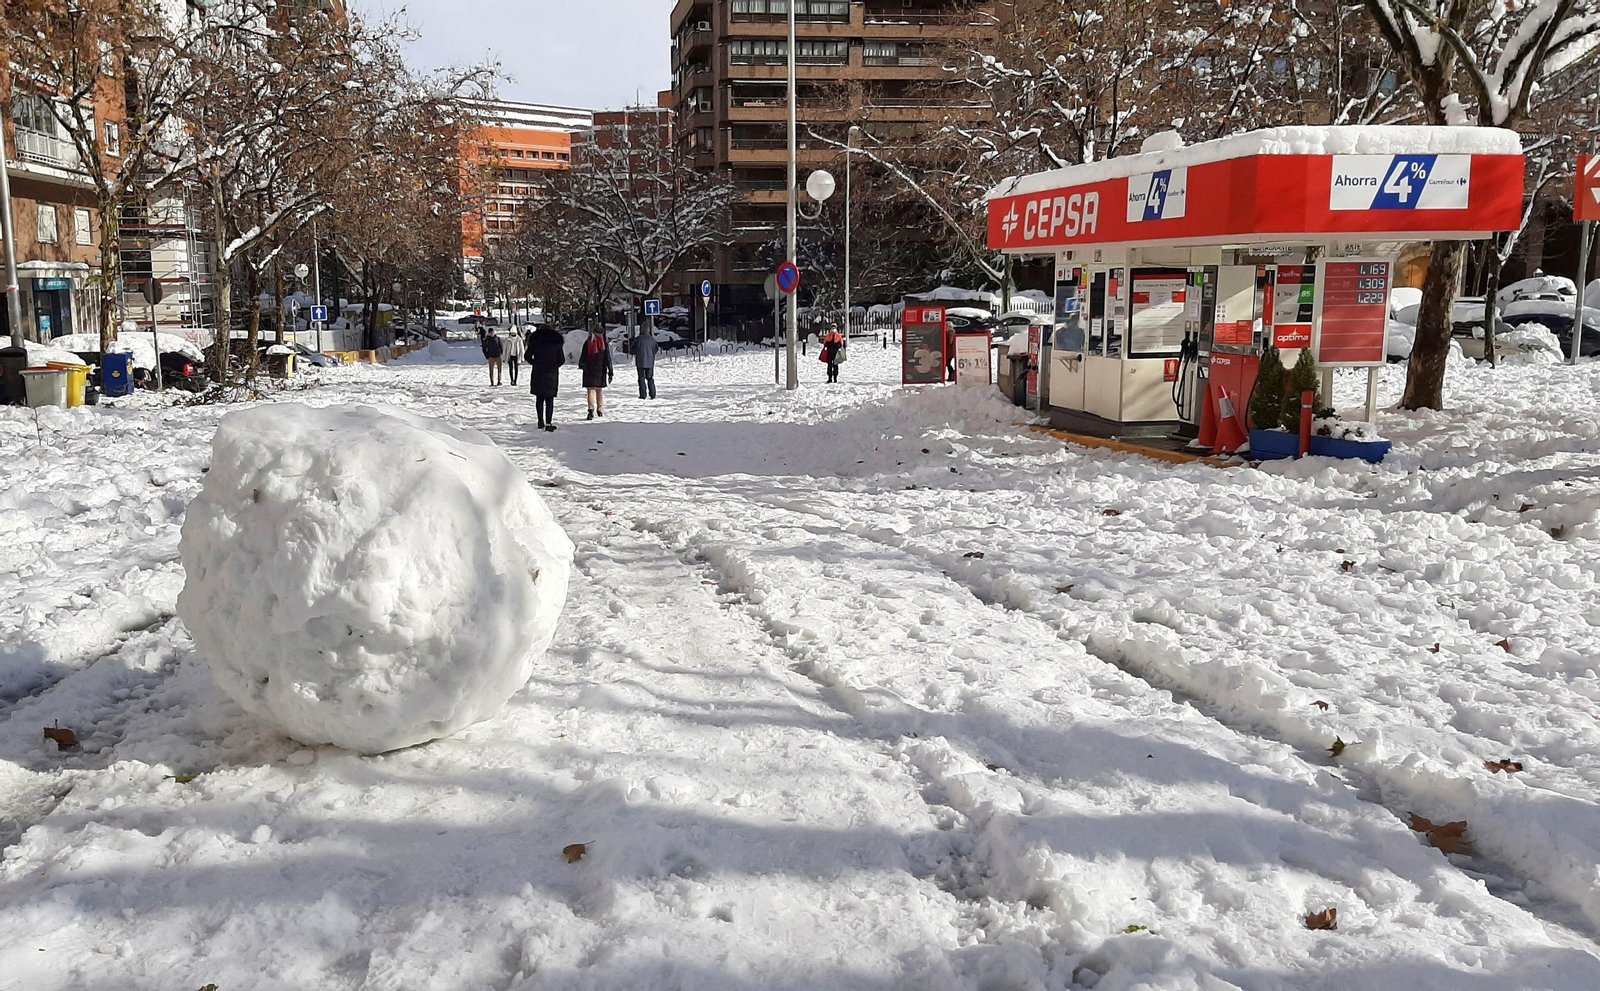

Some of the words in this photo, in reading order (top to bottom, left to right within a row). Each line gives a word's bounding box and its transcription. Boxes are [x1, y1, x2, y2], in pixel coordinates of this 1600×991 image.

[1334, 174, 1377, 187] Ahorra
[1383, 161, 1427, 203] 4%
[1129, 191, 1146, 202] Ahorra
[1147, 177, 1167, 214] 4%
[1023, 191, 1099, 241] CEPSA
[1360, 264, 1386, 275] 1.169
[1359, 278, 1385, 289] 1.309
[1357, 292, 1384, 304] 1.229
[1277, 331, 1309, 342] optima
